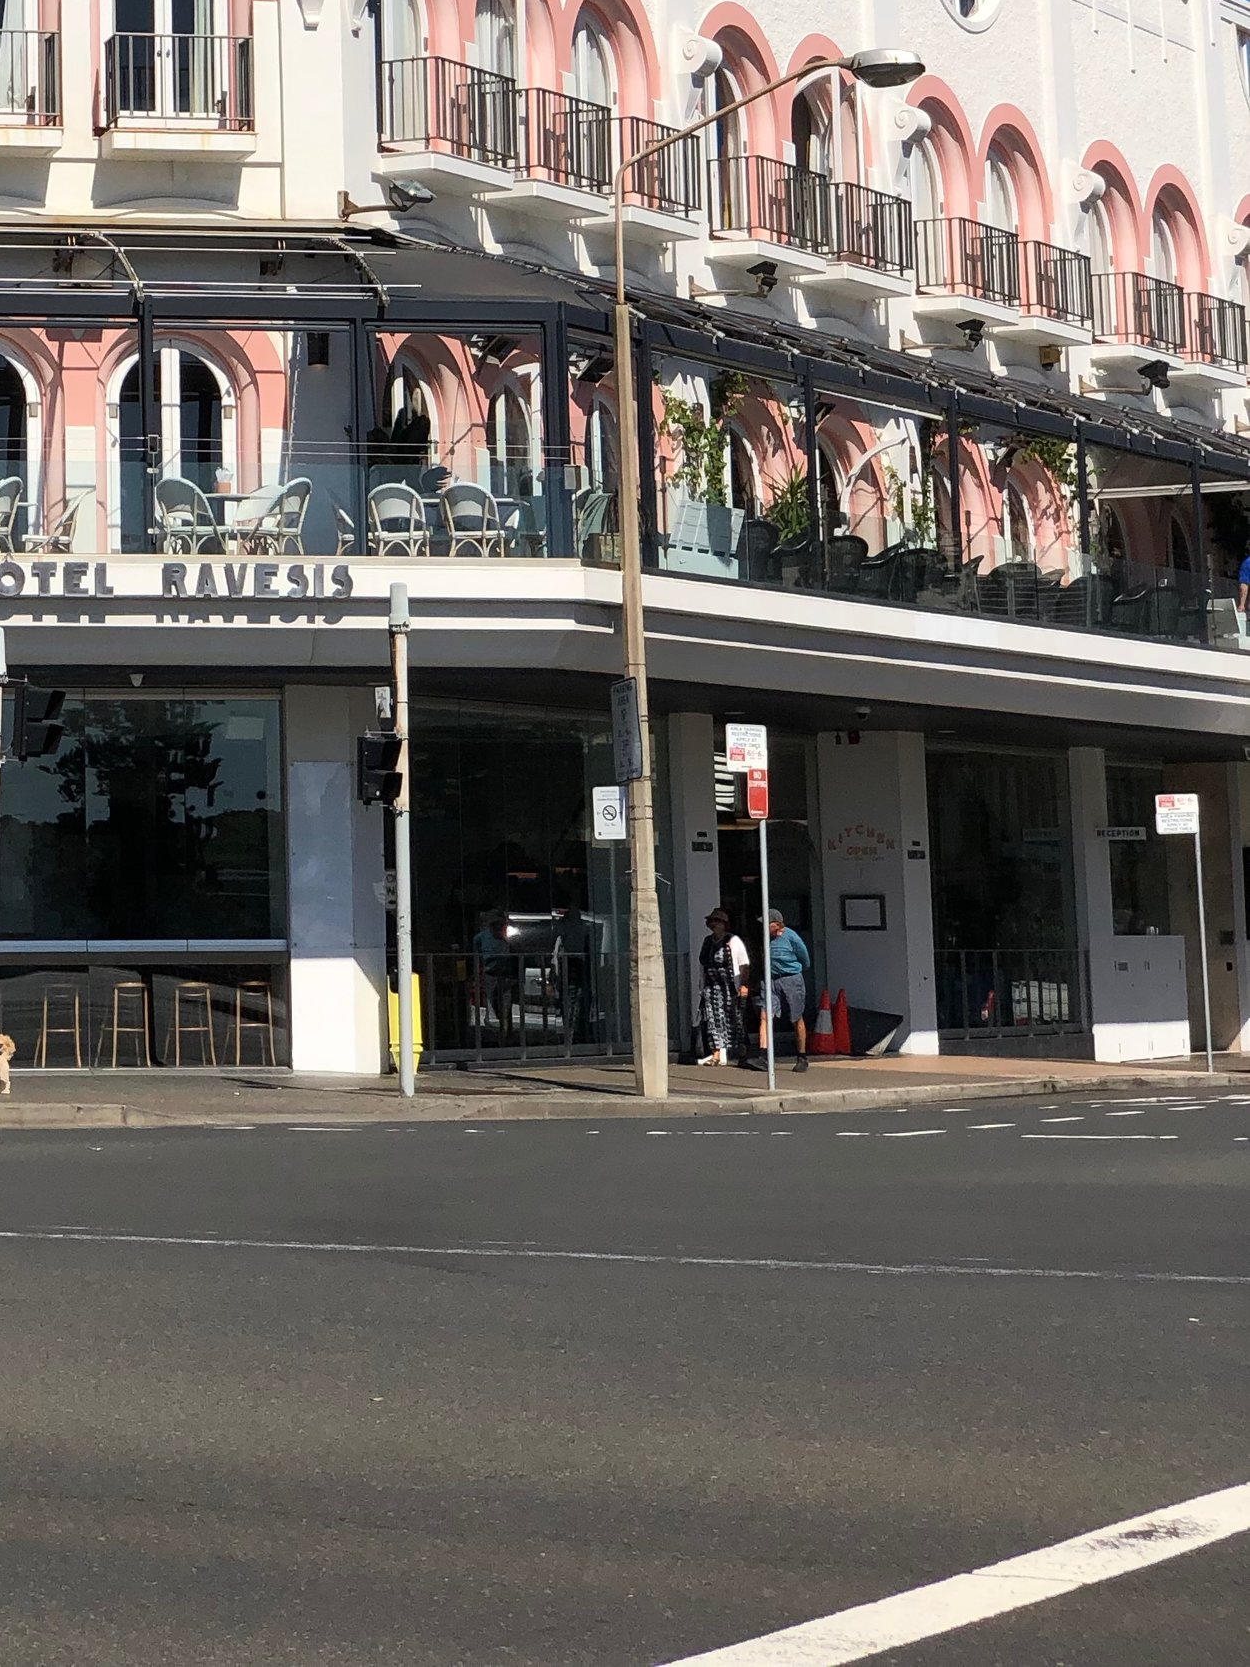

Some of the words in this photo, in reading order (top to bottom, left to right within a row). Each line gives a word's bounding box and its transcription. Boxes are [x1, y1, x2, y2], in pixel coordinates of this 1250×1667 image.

[161, 561, 354, 599] RAVESIS
[1096, 829, 1140, 837] RECEPTION
[846, 846, 878, 855] OPEN
